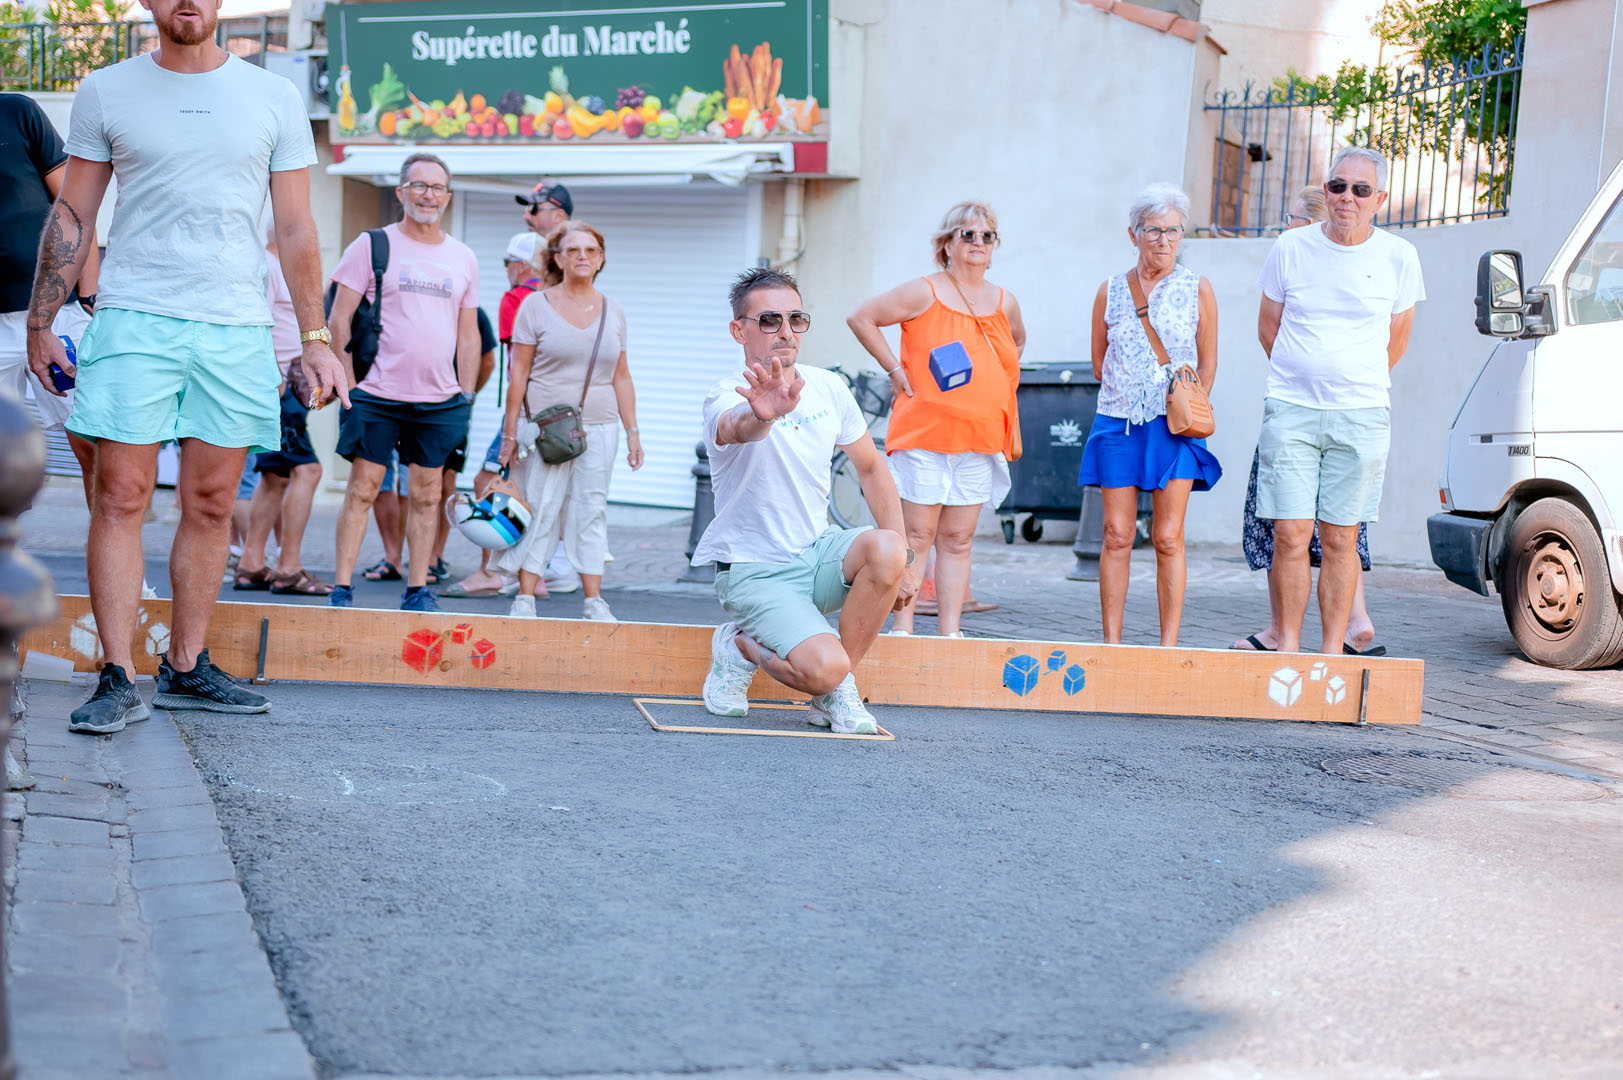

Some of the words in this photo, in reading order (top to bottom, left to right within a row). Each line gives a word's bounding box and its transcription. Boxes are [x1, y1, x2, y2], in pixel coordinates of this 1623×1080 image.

[411, 25, 537, 65] Supérette
[541, 25, 578, 57] du
[584, 18, 691, 56] Marché
[1508, 446, 1530, 455] T1400
